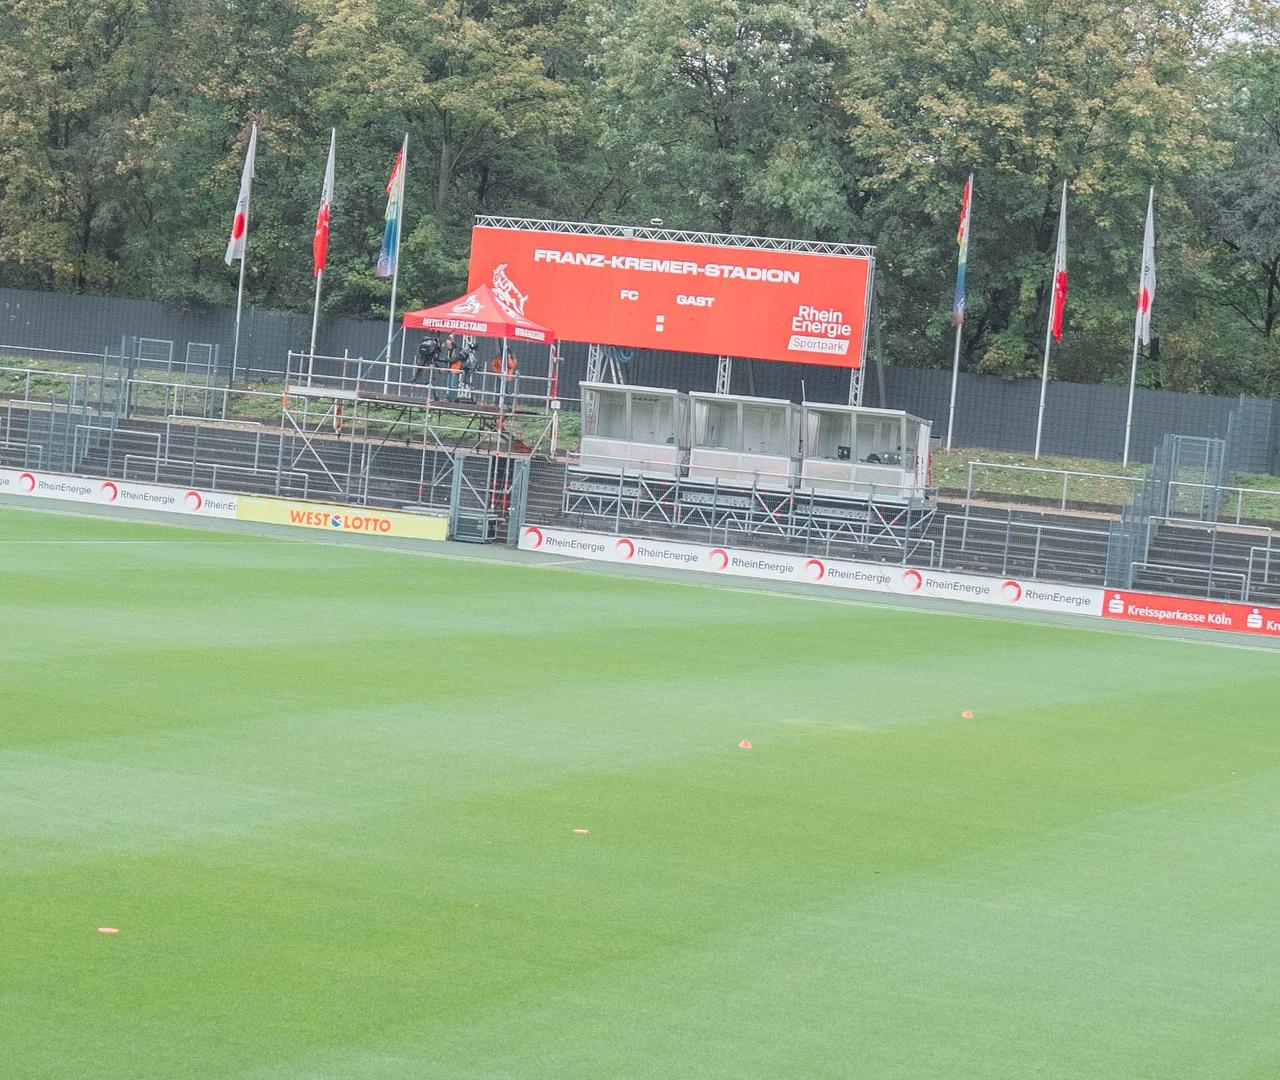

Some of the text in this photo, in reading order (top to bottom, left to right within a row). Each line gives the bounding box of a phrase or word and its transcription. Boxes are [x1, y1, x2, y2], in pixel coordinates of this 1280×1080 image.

[534, 249, 800, 284] FRANZ-KREMER-STADION
[620, 289, 639, 301] FC
[676, 295, 715, 307] GAST
[799, 305, 842, 323] Rhein
[422, 317, 488, 332] MITGLIEDERSTAND
[792, 316, 851, 337] Energie
[793, 337, 844, 351] Sportpark
[38, 480, 92, 495] RheinEnergie
[120, 489, 175, 505] RheinEnergie
[290, 509, 392, 533] WEST LOTTO
[545, 536, 605, 553] RheinEnergie
[637, 547, 698, 563] RheinEnergie
[732, 557, 794, 574] RheinEnergie
[828, 567, 891, 584] RheinEnergie
[926, 578, 990, 595] RheinEnergie
[1025, 589, 1091, 607] RheinEnergie
[1127, 604, 1232, 626] Kreissparkasse Köln
